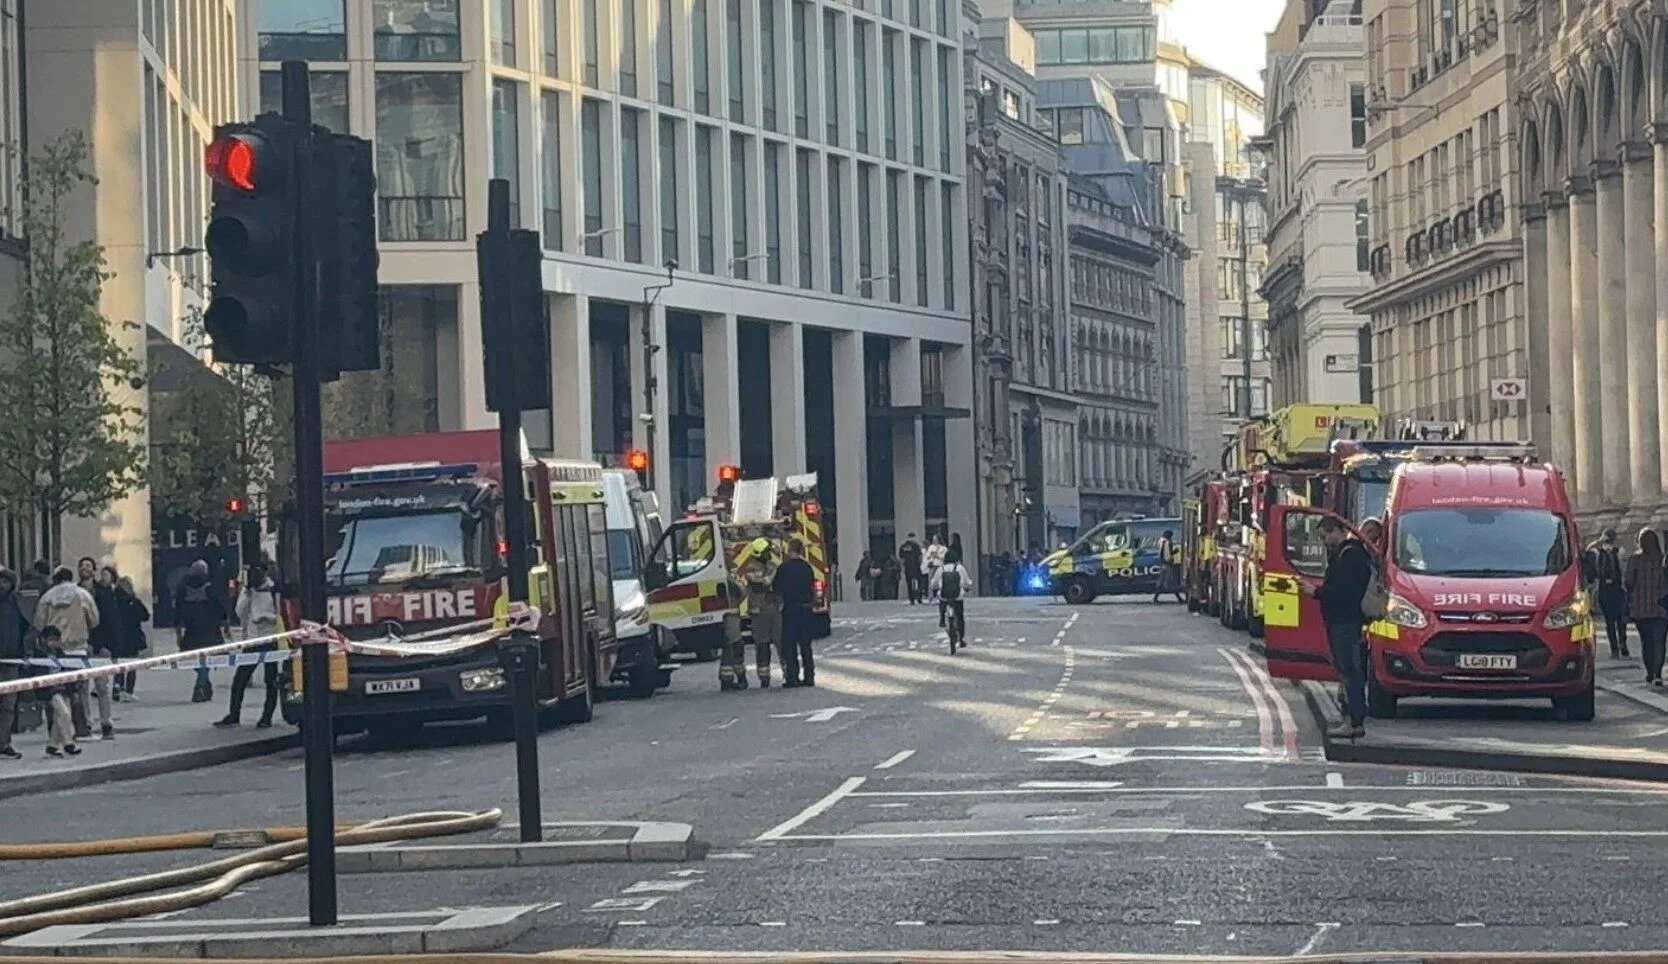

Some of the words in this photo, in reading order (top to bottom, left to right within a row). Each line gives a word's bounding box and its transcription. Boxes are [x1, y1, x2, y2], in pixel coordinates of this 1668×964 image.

[1108, 565, 1161, 578] POLIC
[403, 589, 477, 621] FIRE
[1488, 593, 1537, 607] FIRE
[1491, 656, 1513, 667] FTY
